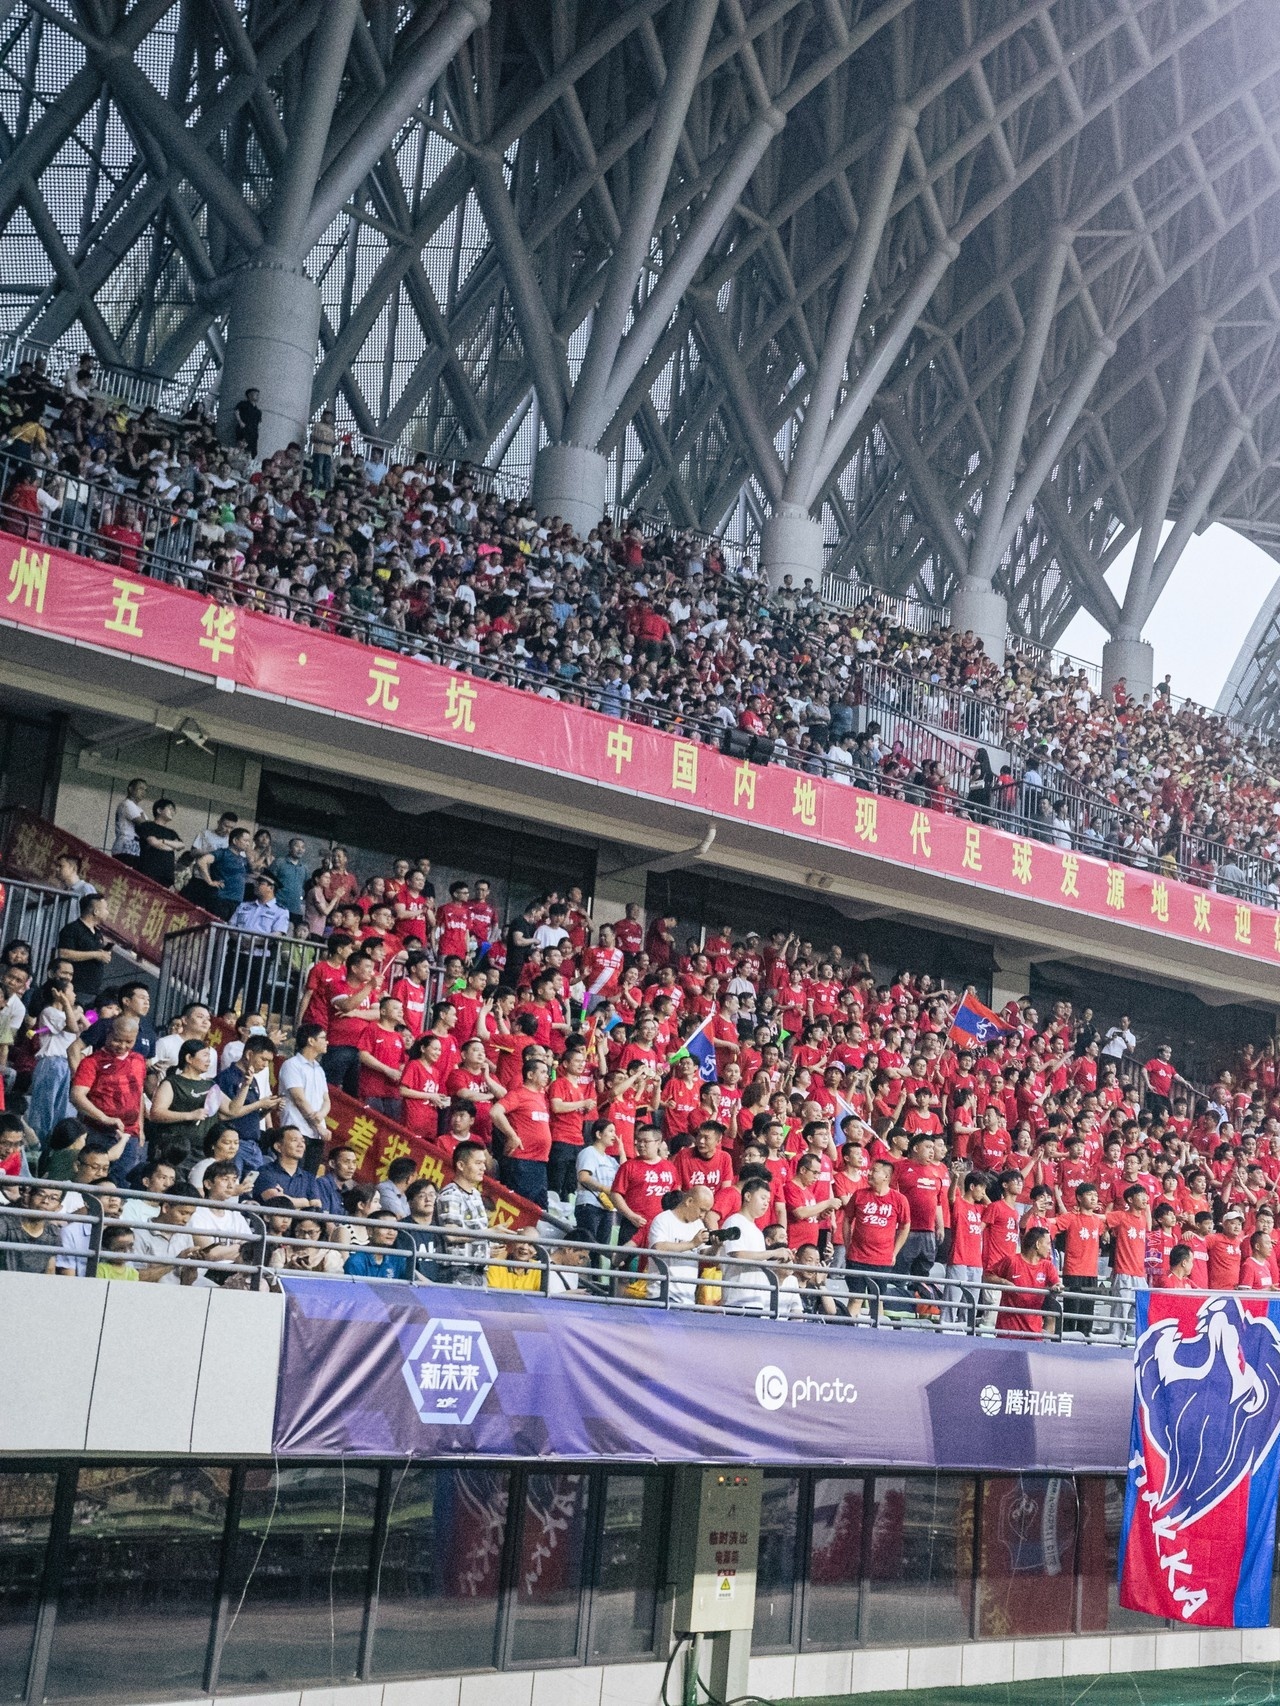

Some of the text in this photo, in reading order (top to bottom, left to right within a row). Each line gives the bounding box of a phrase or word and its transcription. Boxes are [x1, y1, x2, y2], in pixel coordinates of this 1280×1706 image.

[432, 1333, 473, 1361] 共创
[420, 1362, 480, 1391] 新未来
[792, 1375, 858, 1409] photo
[1005, 1389, 1074, 1417] 腾讯体育
